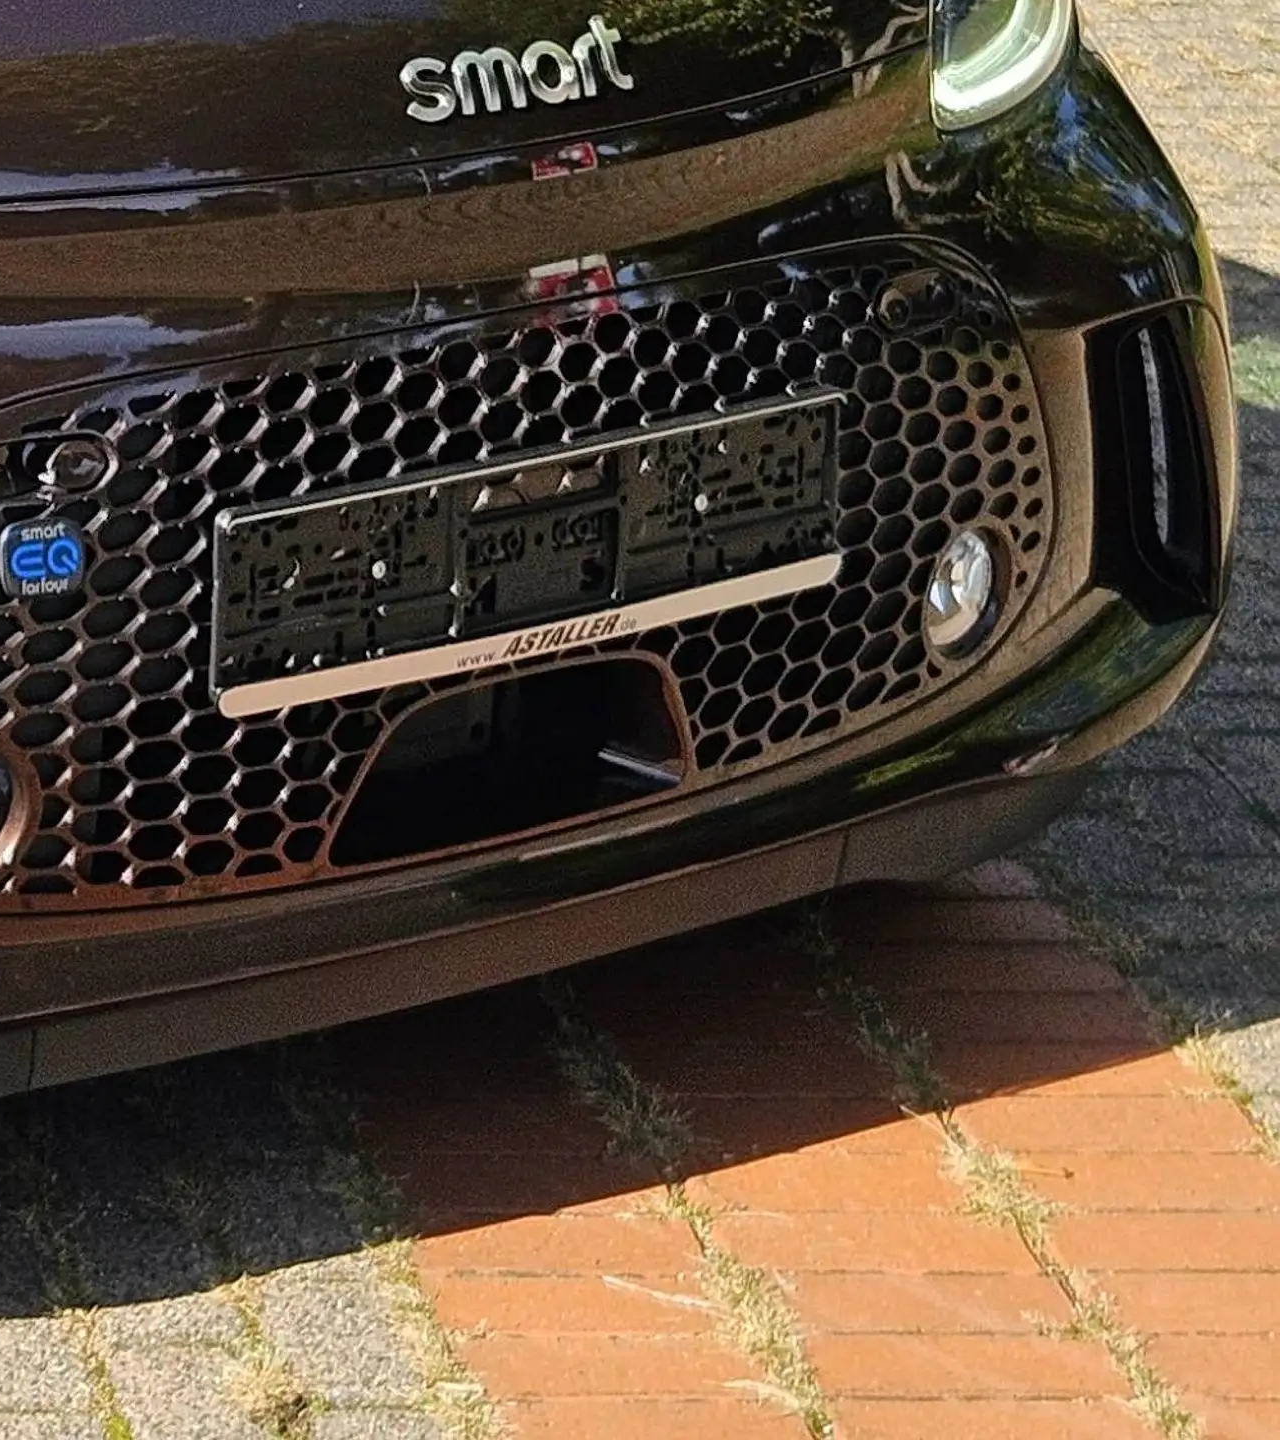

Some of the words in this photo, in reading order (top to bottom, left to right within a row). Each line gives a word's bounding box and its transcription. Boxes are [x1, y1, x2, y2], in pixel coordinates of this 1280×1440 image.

[399, 15, 635, 123] smart
[20, 521, 66, 541] smart
[11, 539, 79, 578] EQ
